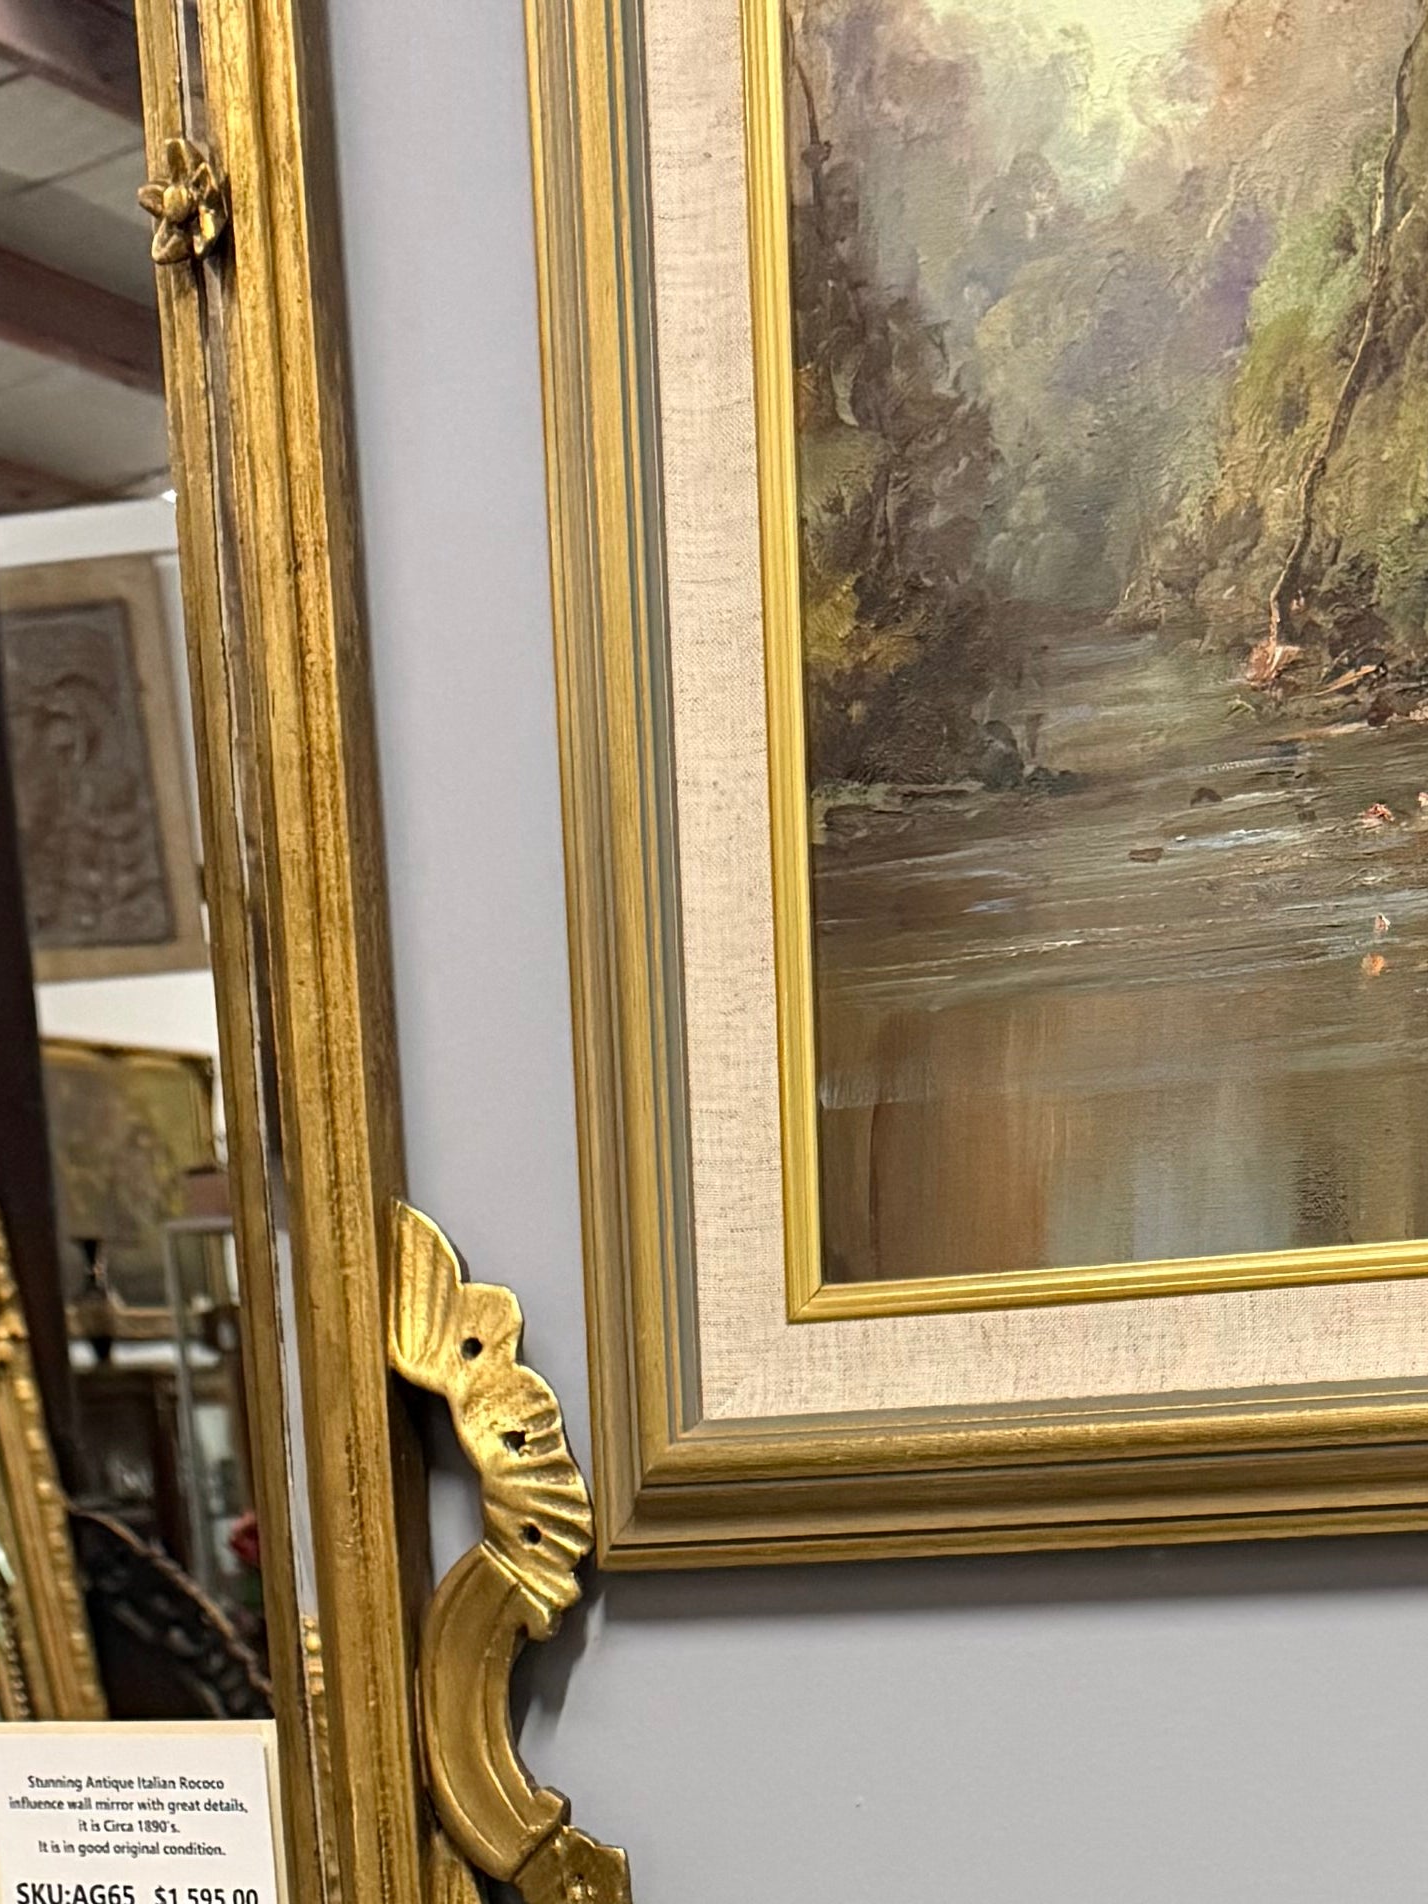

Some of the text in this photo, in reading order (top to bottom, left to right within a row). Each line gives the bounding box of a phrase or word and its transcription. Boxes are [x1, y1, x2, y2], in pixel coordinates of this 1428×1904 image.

[28, 1775, 224, 1791] Stunning Antique Italian Rococo
[9, 1797, 248, 1813] influence wall mirror with great details,
[104, 1820, 133, 1832] Circa
[63, 1841, 226, 1858] in good original condition.
